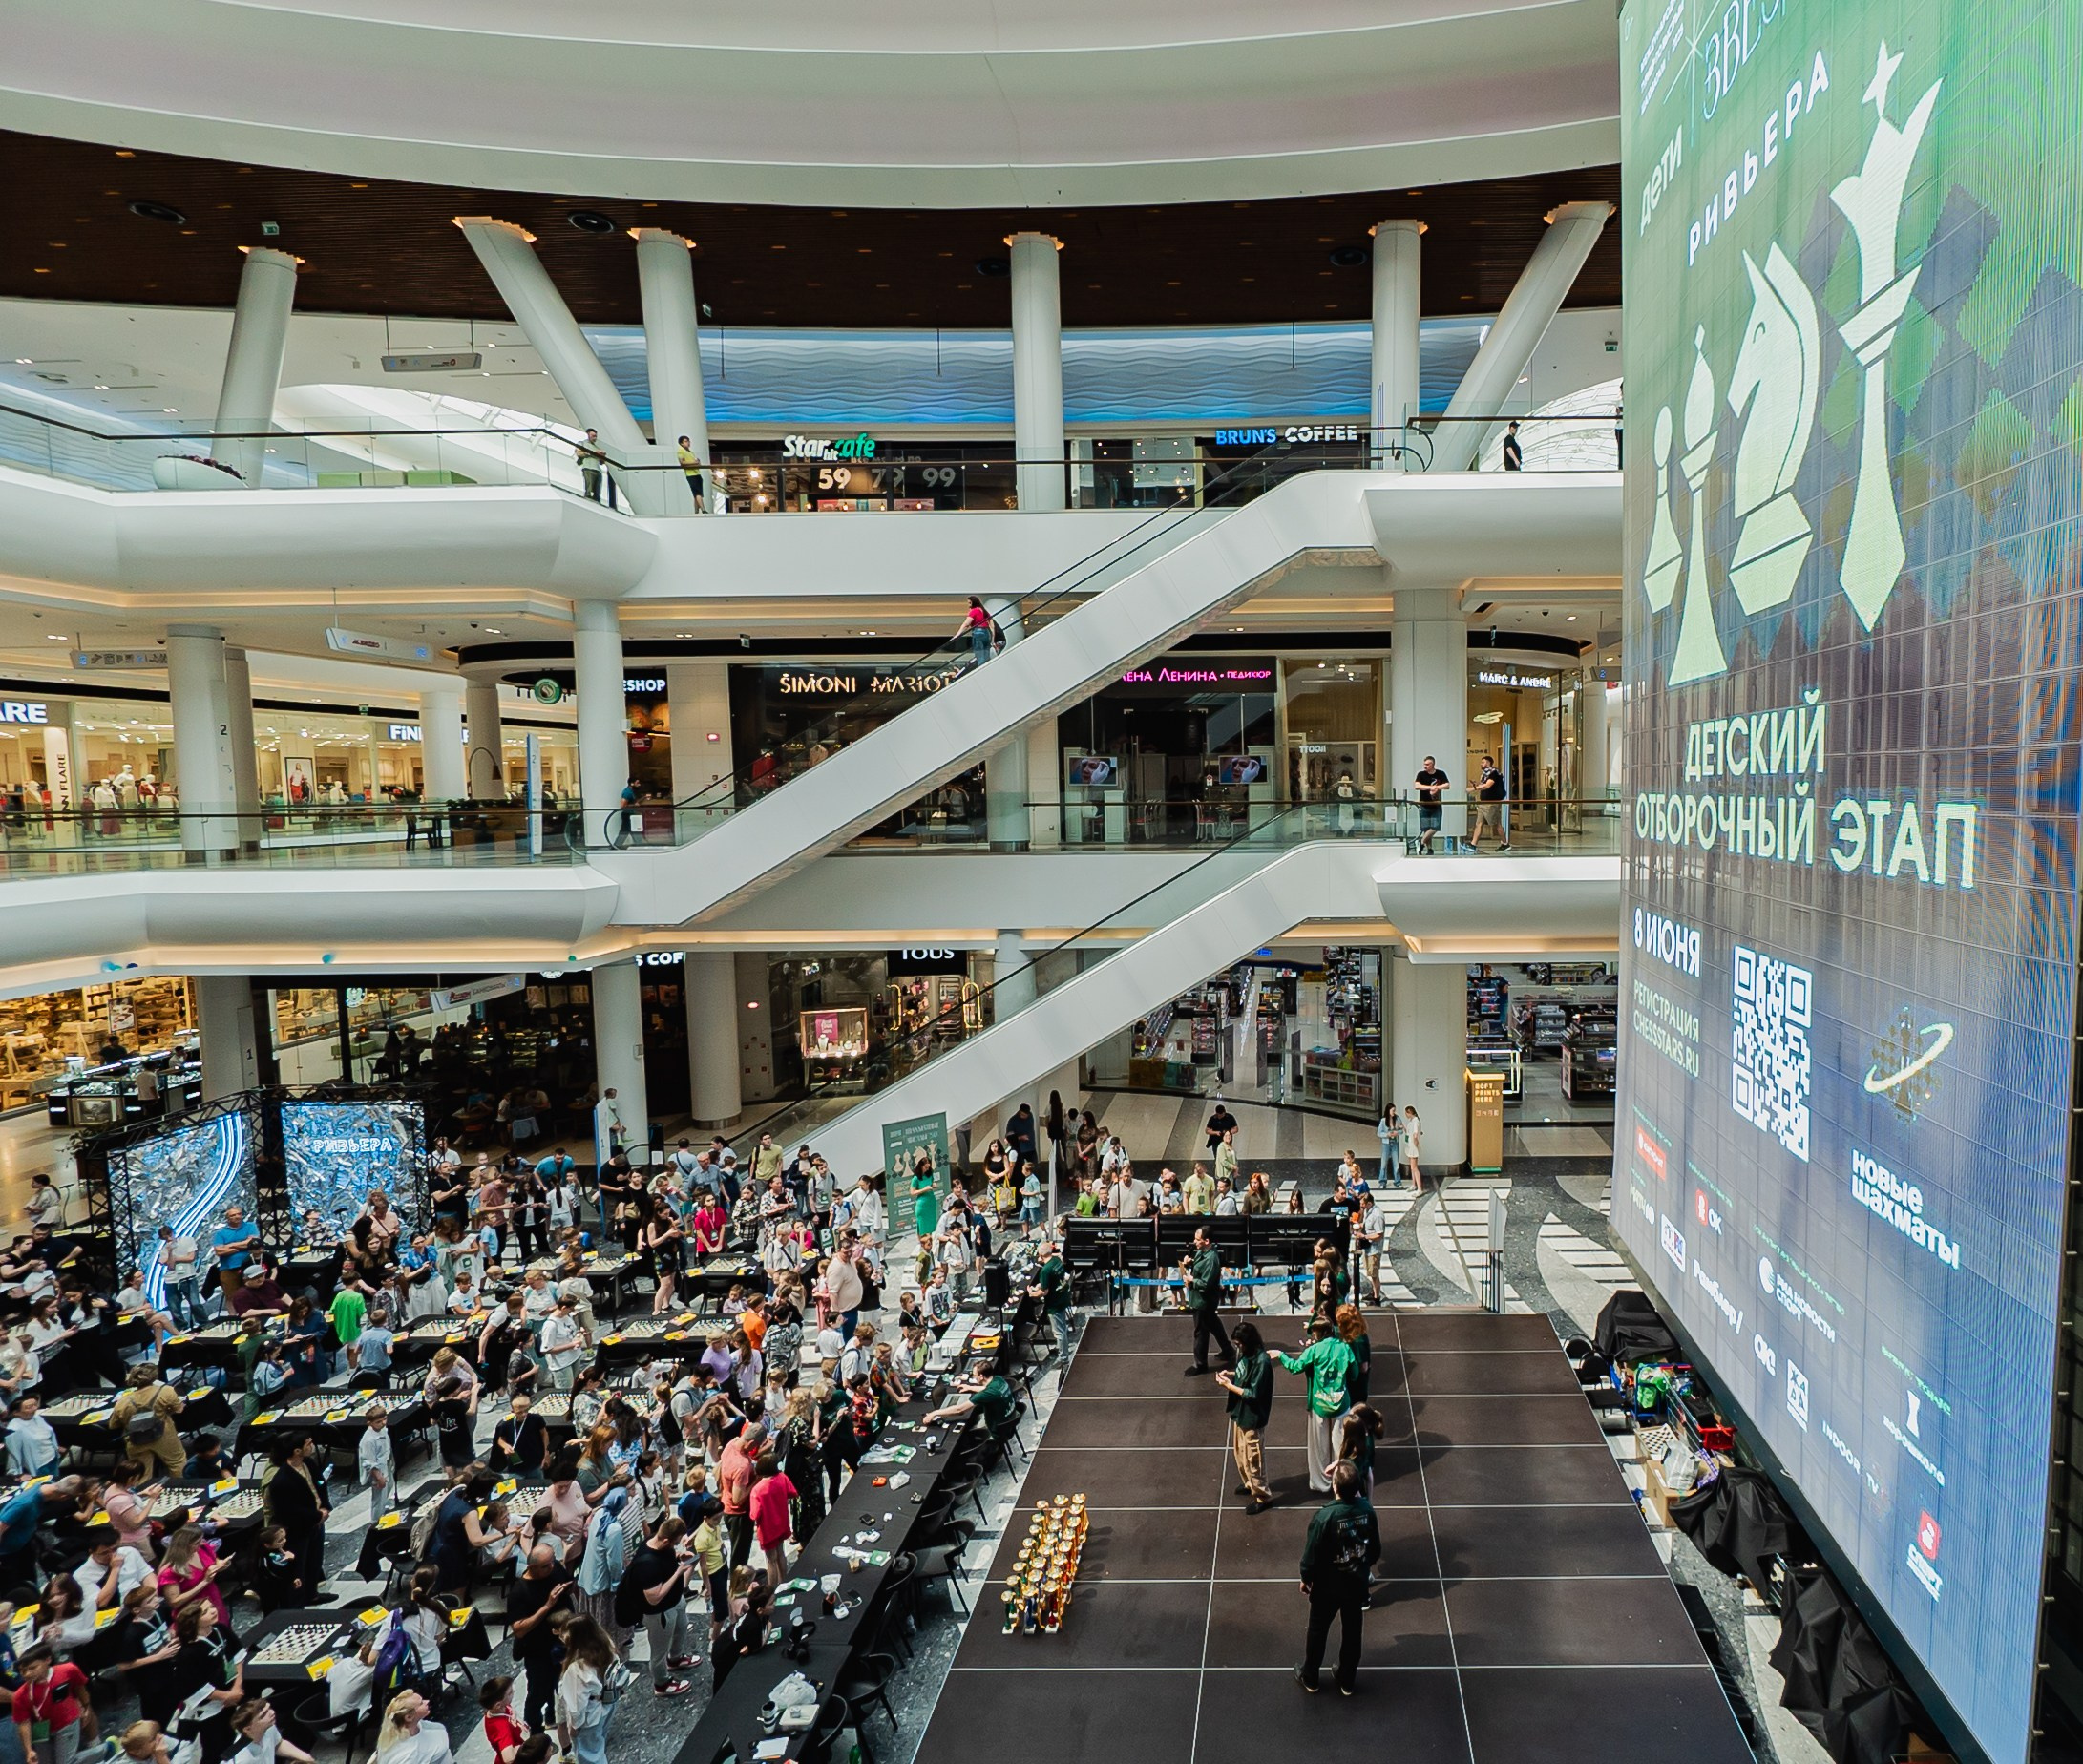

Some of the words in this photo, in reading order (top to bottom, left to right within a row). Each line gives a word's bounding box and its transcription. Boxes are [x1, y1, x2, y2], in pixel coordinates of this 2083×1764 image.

[1689, 50, 1829, 267] РИВЬЕРА
[1640, 124, 1683, 238] дети
[783, 434, 831, 457] Star
[1215, 428, 1276, 445] BRUN'S
[1284, 425, 1357, 443] COFFEE
[818, 467, 852, 490] 59
[922, 467, 956, 488] 99
[1479, 672, 1508, 685] MARC
[220, 724, 228, 735] 2
[1685, 688, 1826, 782] ДЕТСКИЙ
[1635, 782, 1814, 864] ОТБОРОЧНЫЙ
[1830, 799, 1977, 889] ЭТАП
[1634, 907, 1643, 948] 8
[1646, 912, 1700, 978] ИЮНЯ
[1633, 979, 1699, 1043] РЕГИСТРАЦИЯ
[246, 1048, 254, 1060] 1
[313, 1138, 393, 1153] РИВЬЕРА
